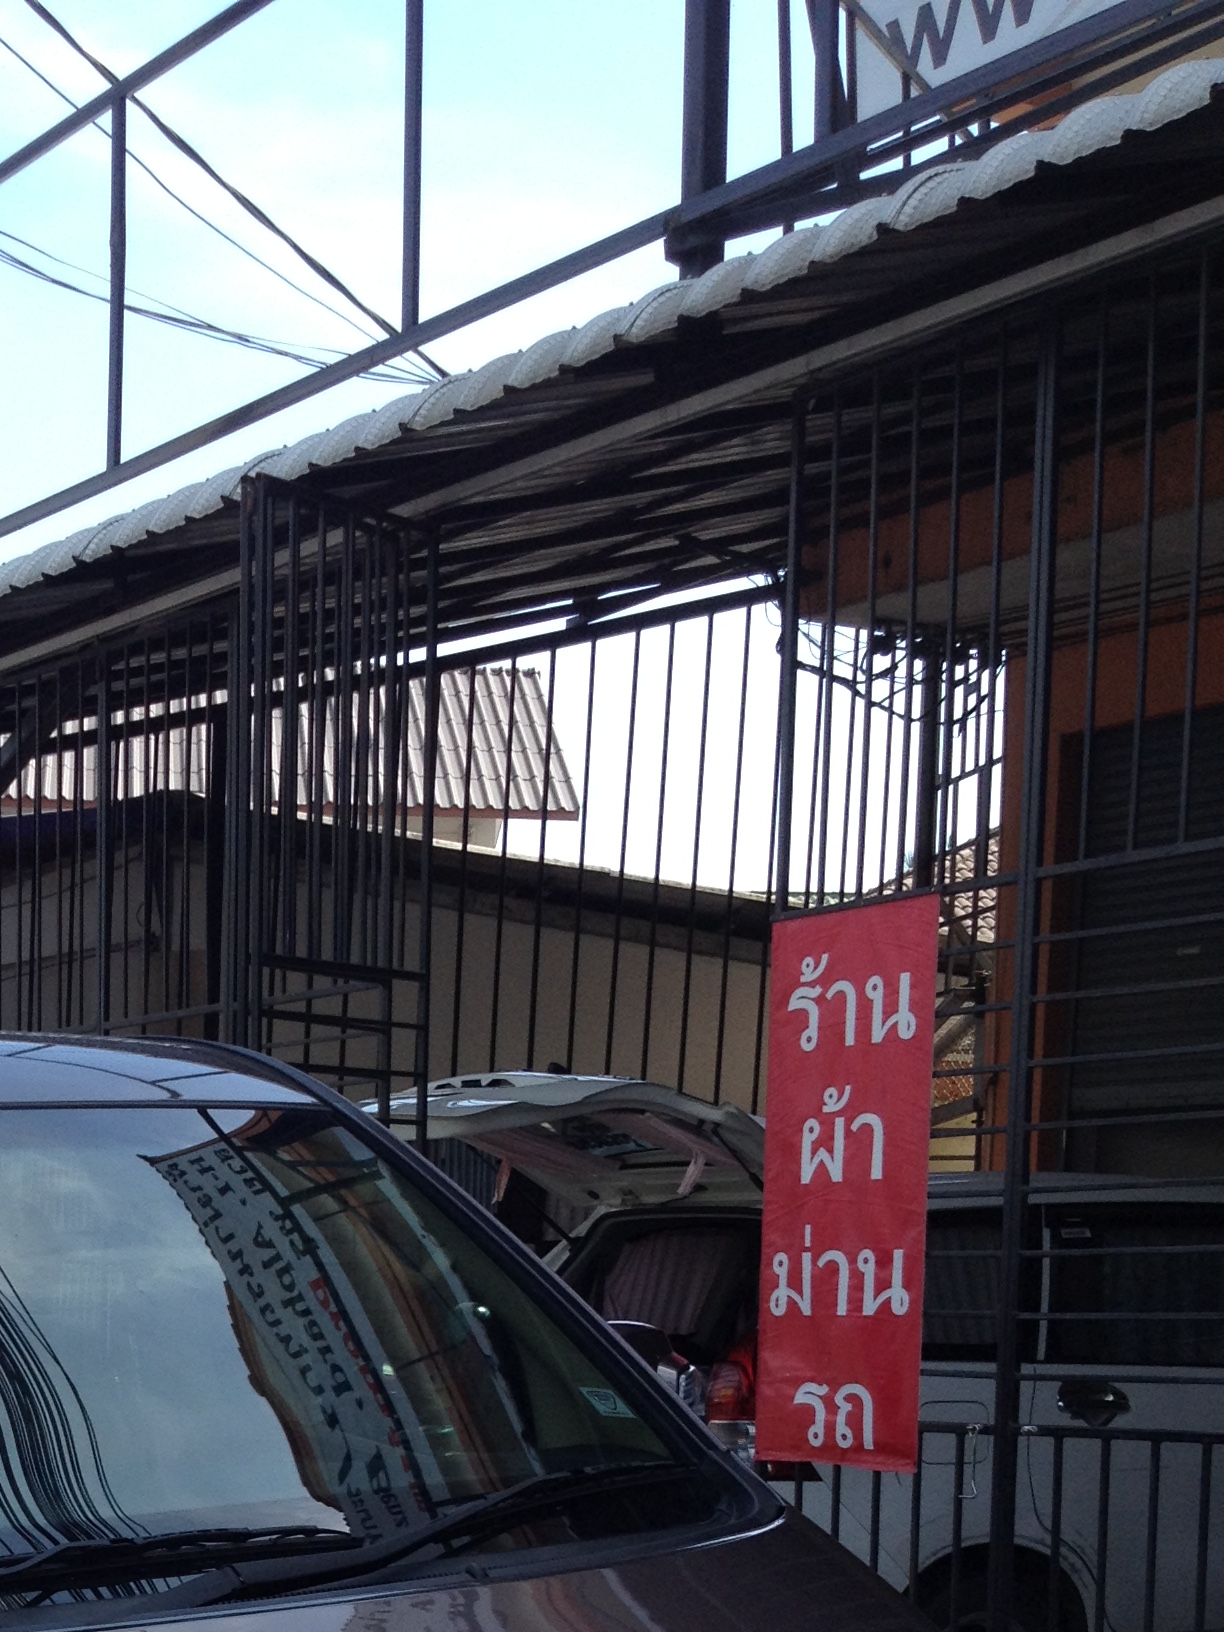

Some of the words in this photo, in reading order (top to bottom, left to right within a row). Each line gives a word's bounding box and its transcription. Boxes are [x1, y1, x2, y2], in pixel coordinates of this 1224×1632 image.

[787, 953, 917, 1052] ร้าน
[799, 1085, 884, 1184] ผ้า
[769, 1224, 910, 1317] ม่าน
[793, 1381, 875, 1450] รถ
